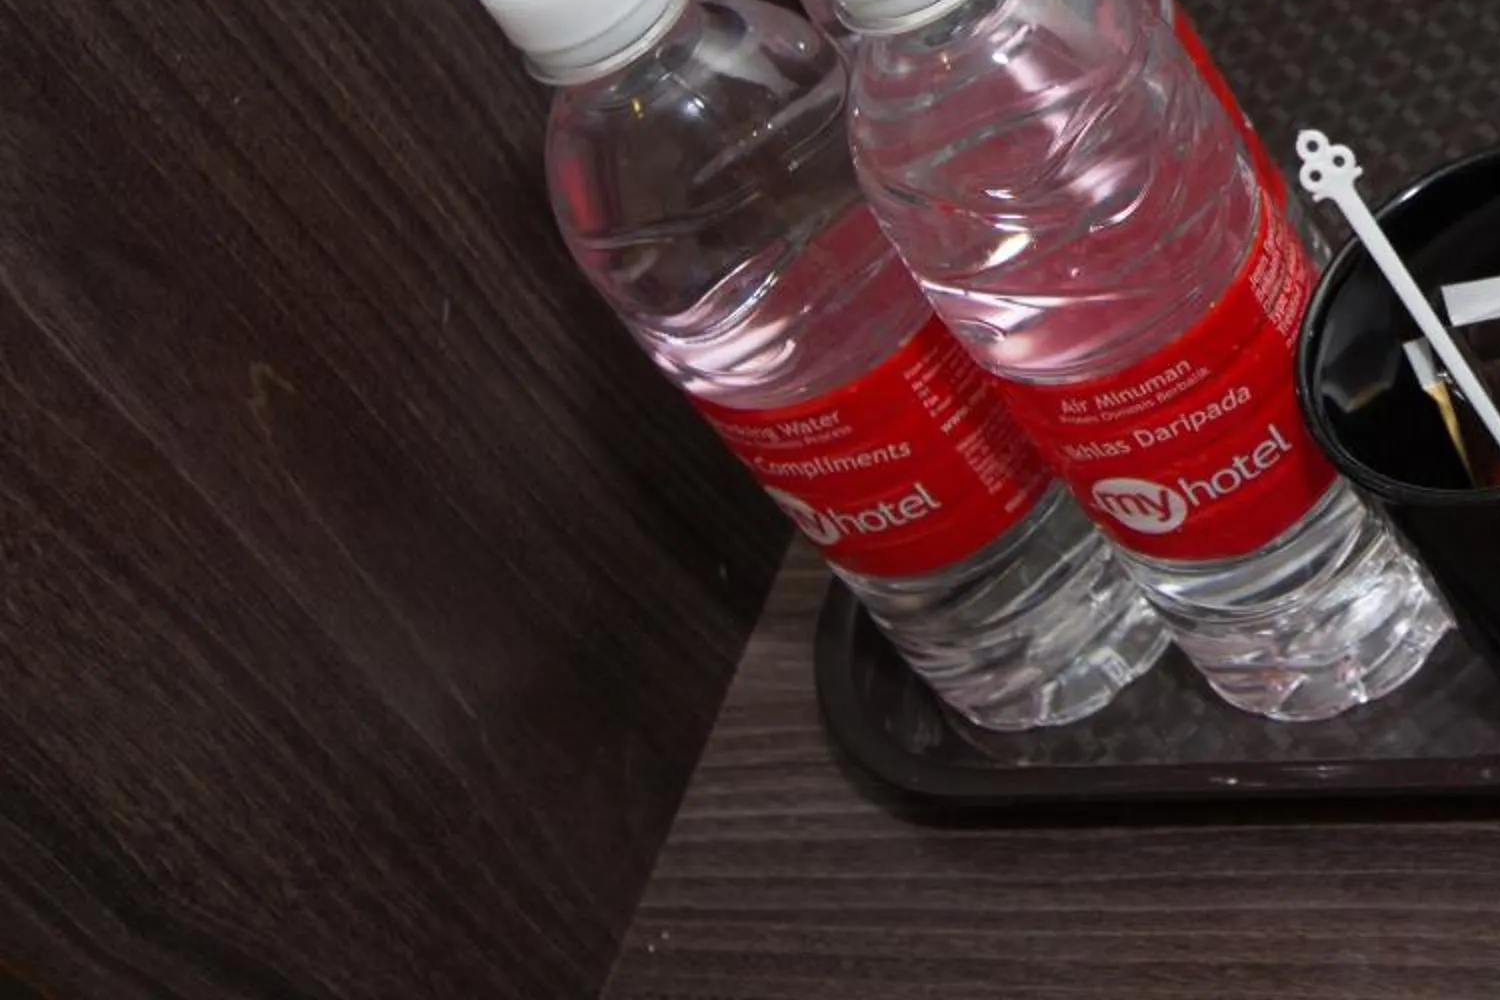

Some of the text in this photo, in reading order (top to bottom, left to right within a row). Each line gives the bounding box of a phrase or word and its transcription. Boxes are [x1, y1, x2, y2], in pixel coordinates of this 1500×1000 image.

[1060, 360, 1192, 414] Air Minuman
[777, 410, 841, 437] Water
[1133, 385, 1252, 449] Daripada
[754, 441, 911, 480] Compliments
